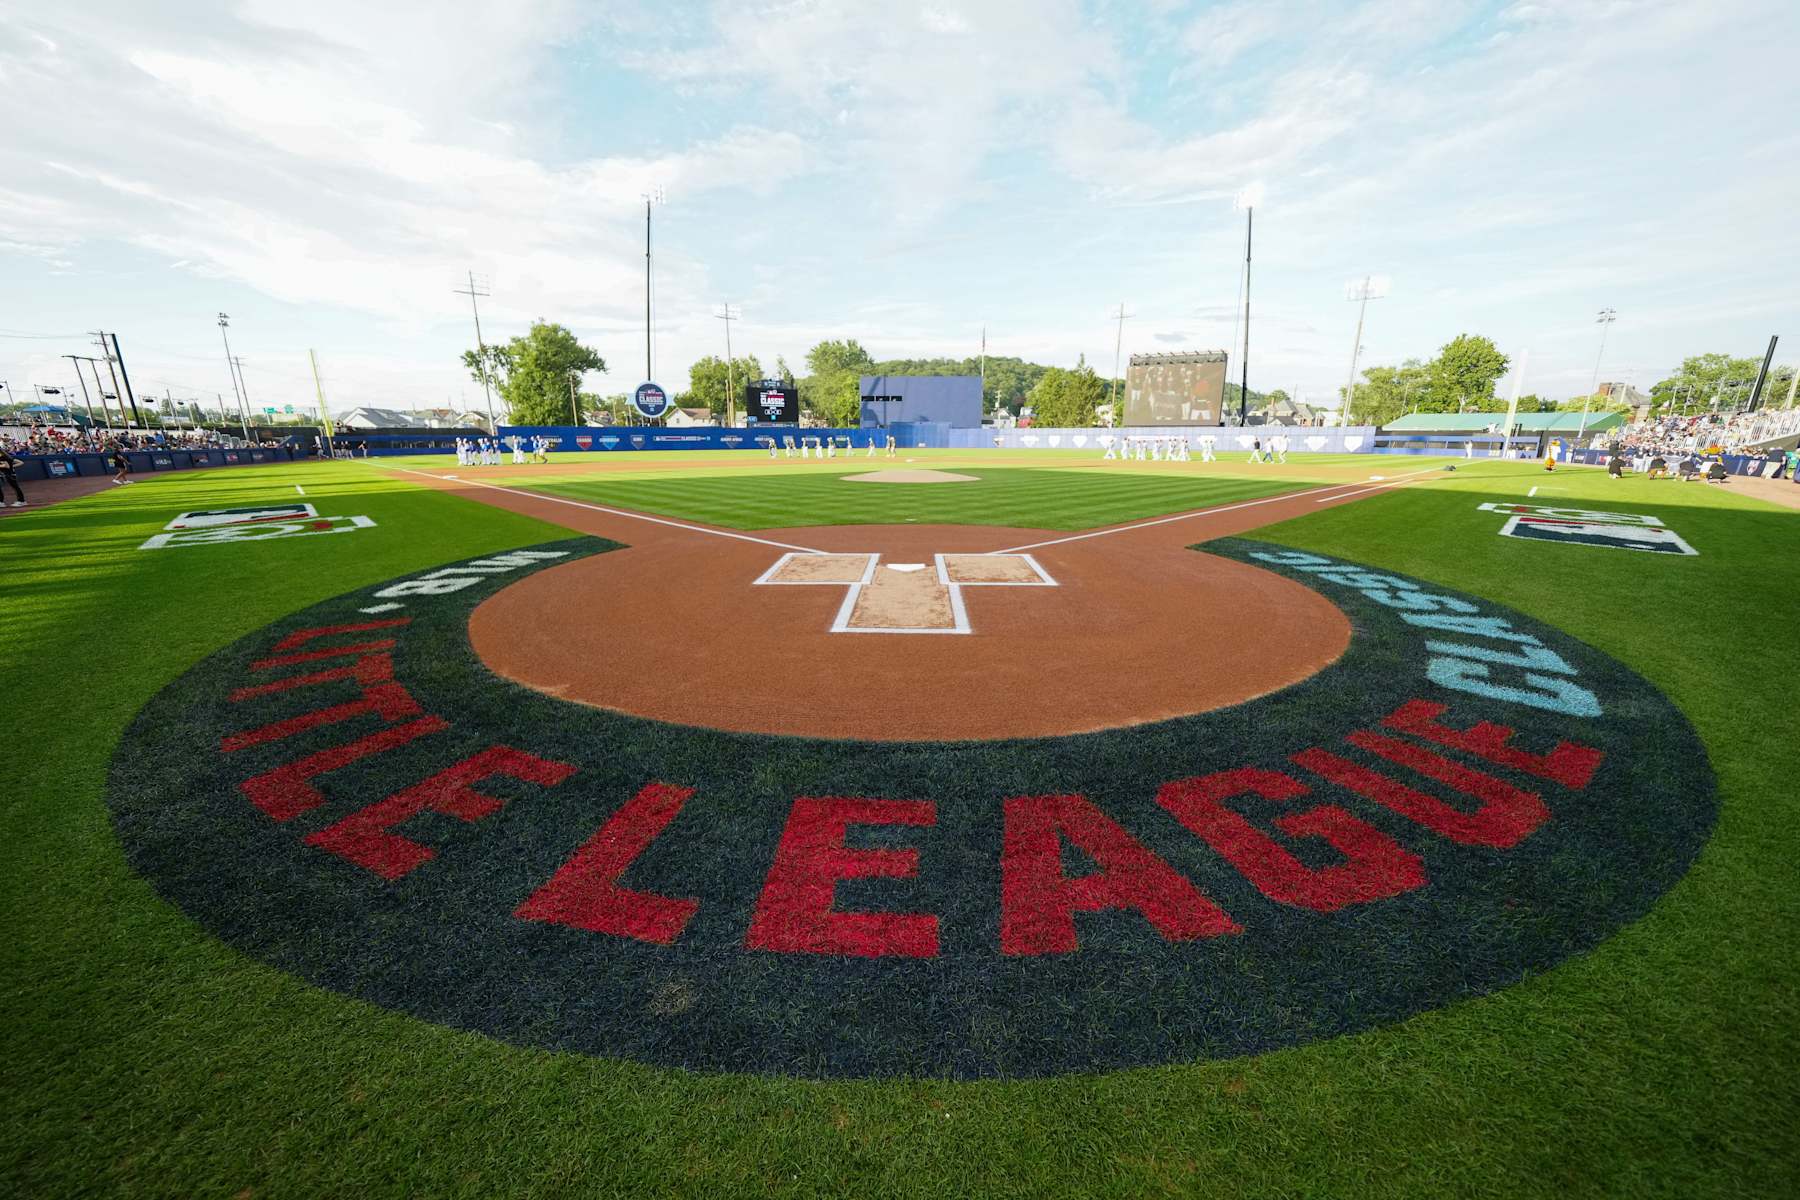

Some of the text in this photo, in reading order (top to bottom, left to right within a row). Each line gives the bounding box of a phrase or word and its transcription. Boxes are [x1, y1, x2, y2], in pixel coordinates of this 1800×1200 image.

[760, 397, 785, 406] CLASSIC
[220, 550, 1604, 958] MLB LITTLE LEAGUE CLASSIC
